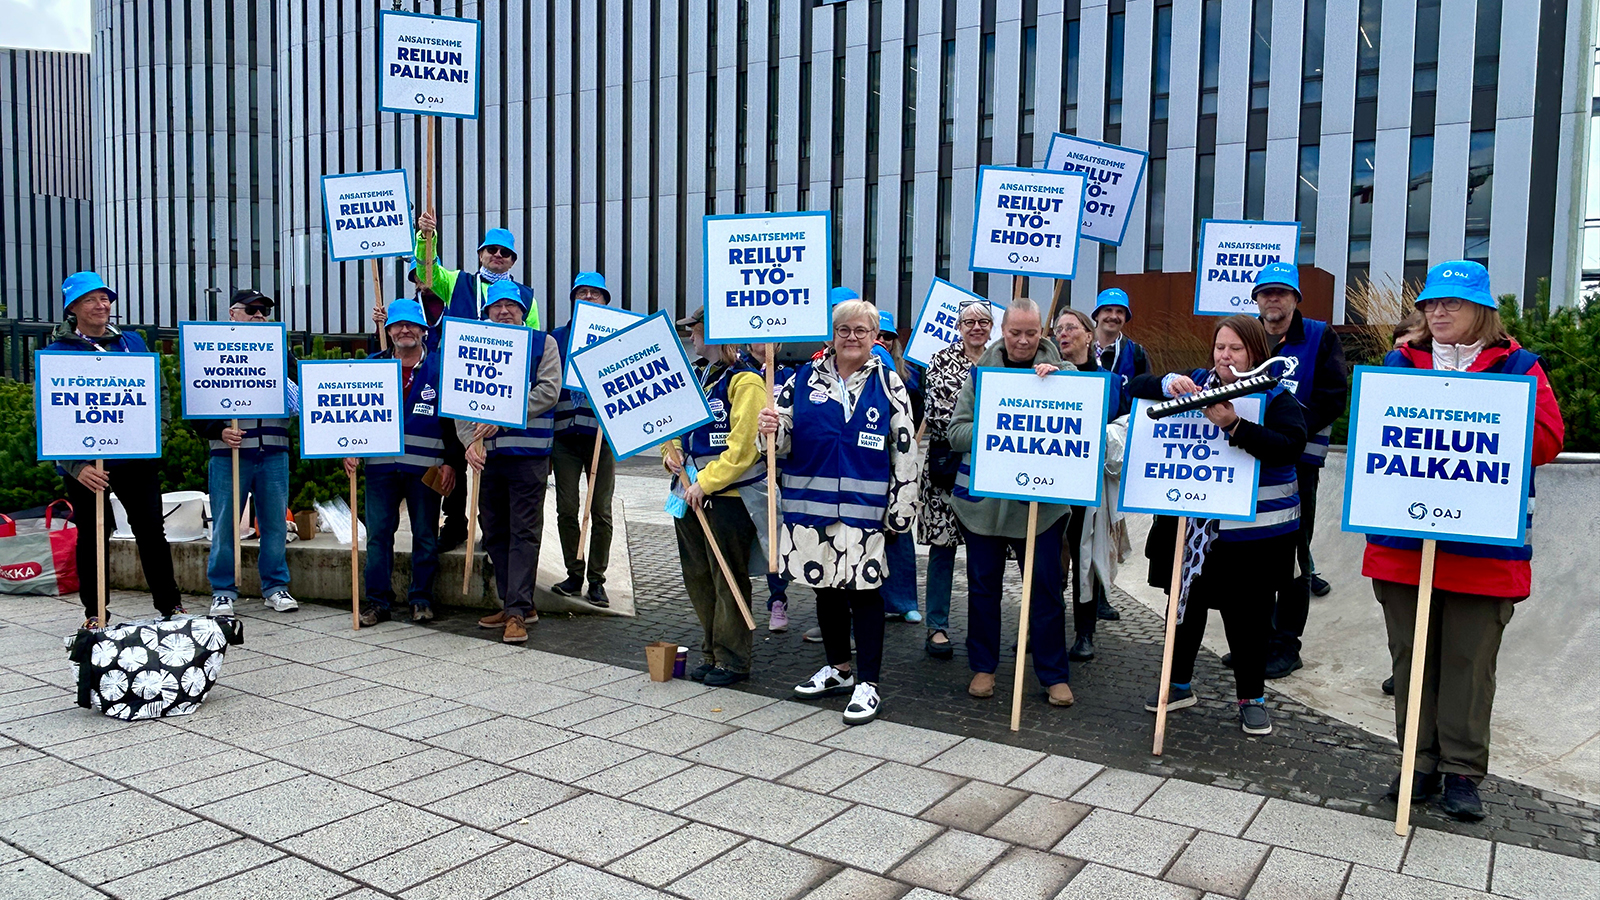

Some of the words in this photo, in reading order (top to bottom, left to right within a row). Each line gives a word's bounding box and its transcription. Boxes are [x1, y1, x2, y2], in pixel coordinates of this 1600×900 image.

[398, 35, 462, 48] ANSAITSEMME
[397, 46, 462, 66] REILUN
[390, 63, 469, 84] PALKAN!
[427, 96, 444, 104] OAJ
[1066, 151, 1126, 170] ANSAITSEMME
[339, 189, 394, 200] ANSAITSEMME
[999, 183, 1065, 194] ANSAITSEMME
[340, 200, 396, 216] REILUN
[997, 194, 1063, 213] REILUT
[1084, 200, 1116, 218] OT!
[335, 214, 404, 231] PALKAN!
[1005, 211, 1050, 229] TYÖ-
[728, 231, 805, 243] ANSAITSEMME
[990, 229, 1062, 248] EHDOT!
[1218, 241, 1281, 251] ANSAITSEMME
[729, 245, 806, 265] REILUT
[1022, 255, 1039, 263] OAJ
[1216, 253, 1280, 267] REILUN
[740, 263, 794, 286] TYÖ-
[726, 288, 809, 307] EHDOT!
[766, 318, 787, 326] OAJ
[459, 334, 513, 348] ANSAITSEMME
[923, 322, 963, 344] PALK
[193, 342, 215, 351] WE
[217, 342, 274, 352] DESERVE
[458, 345, 513, 365] REILUT
[220, 354, 248, 364] FAIR
[598, 343, 661, 379] ANSAITSEMME
[203, 367, 266, 376] WORKING
[465, 361, 503, 379] TYÖ-
[602, 356, 670, 399] REILUN
[50, 377, 65, 387] VI
[68, 375, 146, 387] FÖRTJÄNAR
[193, 379, 277, 389] CONDITIONS!
[317, 381, 383, 389] ANSAITSEMME
[454, 378, 513, 399] EHDOT!
[51, 392, 80, 406] EN
[85, 389, 147, 406] REJÄL
[317, 393, 384, 407] REILUN
[603, 371, 686, 419] PALKAN!
[998, 398, 1083, 411] ANSAITSEMME
[75, 406, 124, 424] LÖN!
[311, 409, 392, 424] PALKAN!
[656, 415, 673, 427] OAJ
[1384, 406, 1501, 424] ANSAITSEMME
[996, 413, 1082, 435] REILUN
[1152, 423, 1229, 440] REILU
[986, 434, 1090, 459] PALKAN!
[1381, 425, 1500, 455] REILUN
[1163, 440, 1220, 460] TYÖ-
[1144, 462, 1235, 484] EHDOT!
[1366, 452, 1511, 485] PALKAN!
[1033, 477, 1054, 485] OAJ
[1184, 492, 1206, 501] OAJ
[1433, 508, 1461, 519] OAJ
